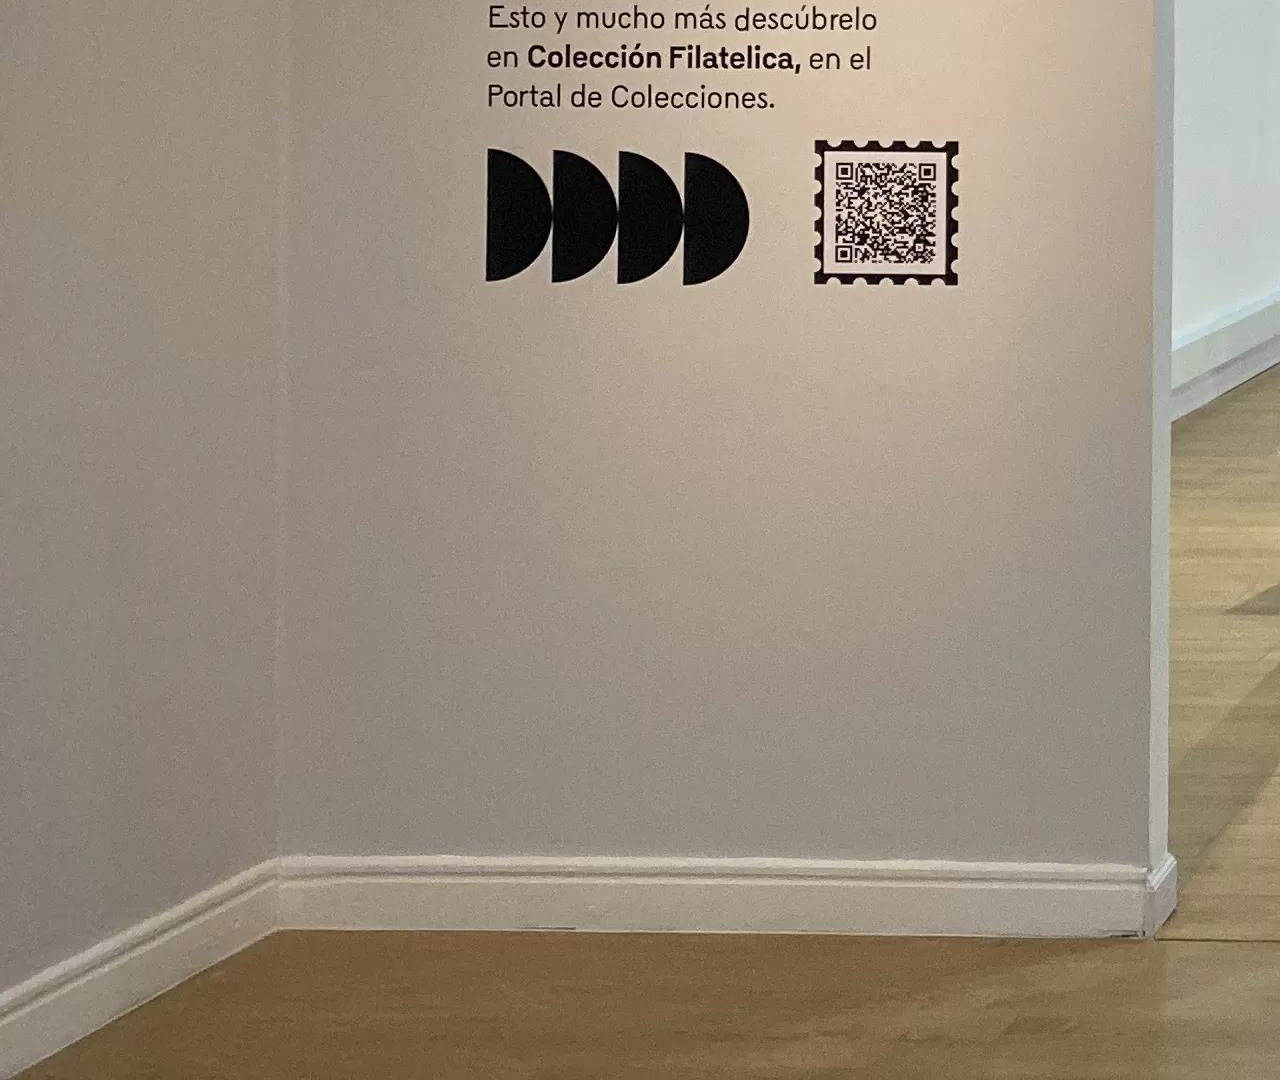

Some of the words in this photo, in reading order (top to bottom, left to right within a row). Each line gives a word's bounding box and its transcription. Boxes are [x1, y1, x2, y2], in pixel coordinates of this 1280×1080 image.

[488, 4, 546, 29] Esto
[553, 11, 568, 35] y
[576, 4, 666, 30] mucho
[674, 3, 727, 30] más
[734, 4, 877, 32] descúbrelo
[487, 50, 519, 68] en
[527, 42, 662, 69] Colección
[669, 43, 801, 75] Filatelica,
[809, 52, 841, 70] en
[849, 45, 871, 71] el
[488, 82, 562, 108] Portal
[570, 83, 603, 109] de
[611, 83, 775, 110] Colecciones.
